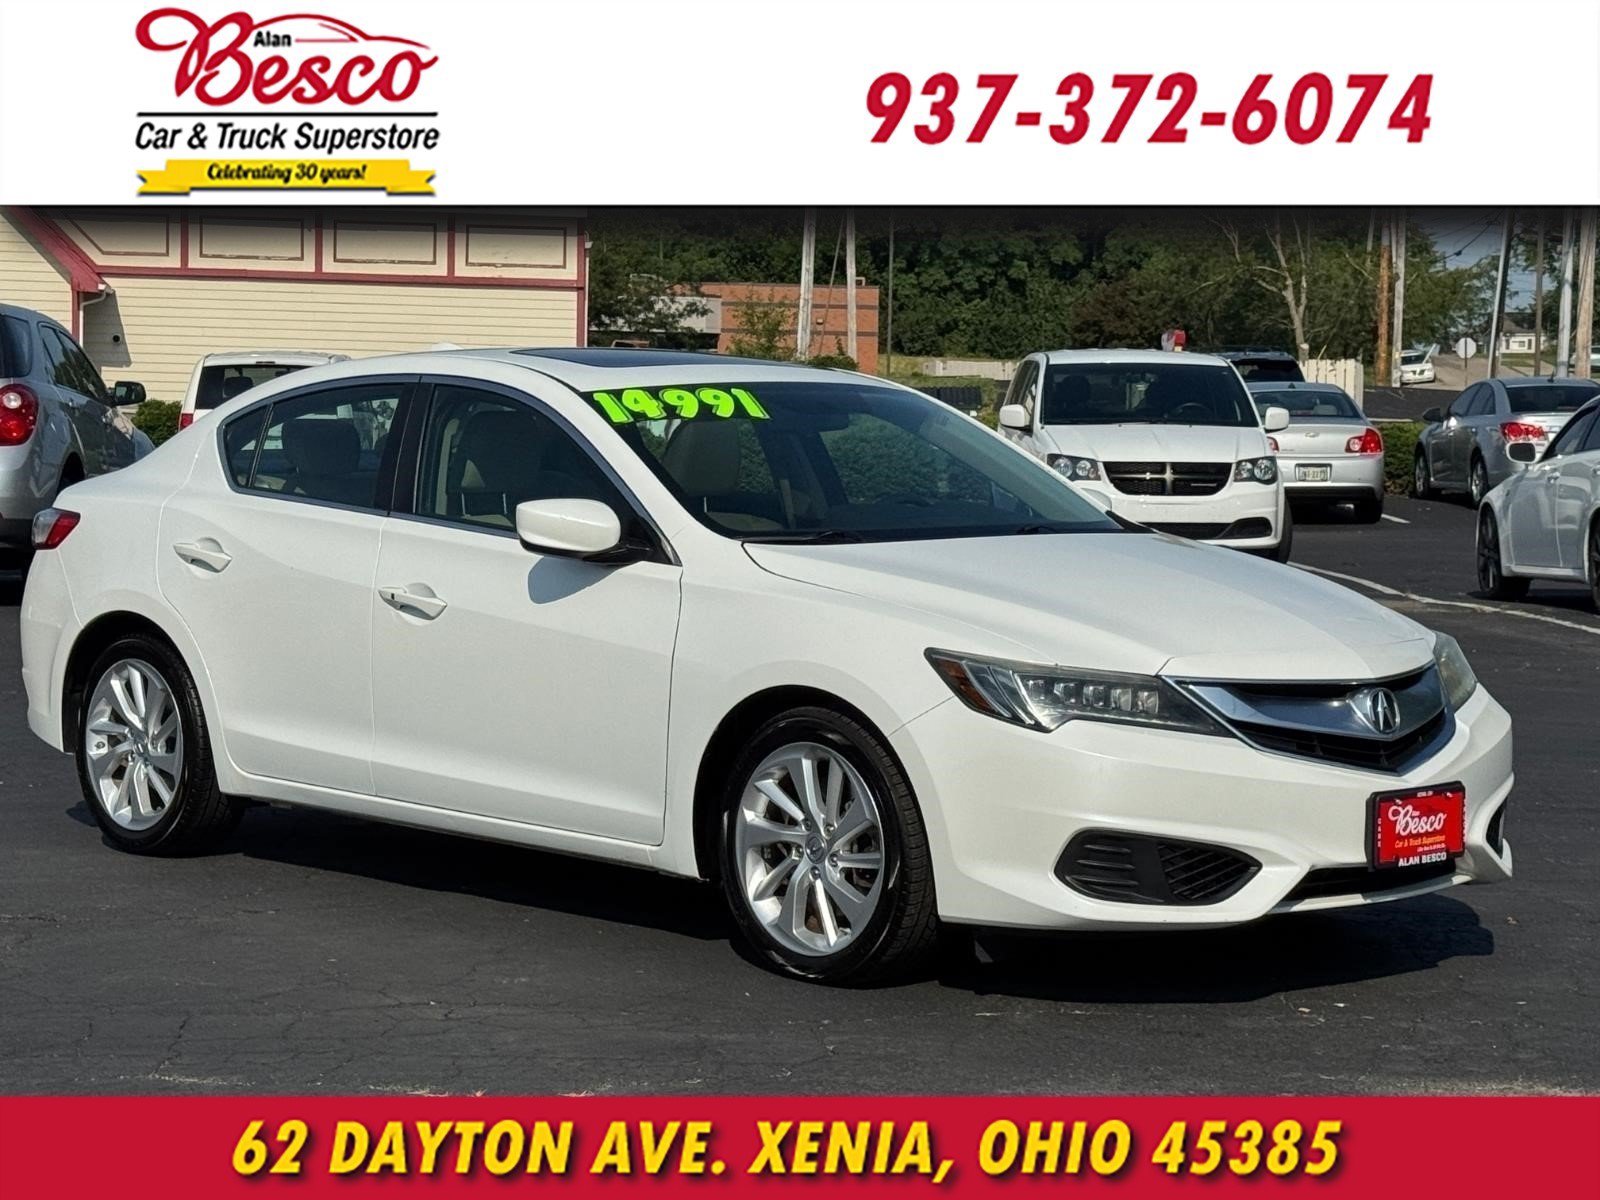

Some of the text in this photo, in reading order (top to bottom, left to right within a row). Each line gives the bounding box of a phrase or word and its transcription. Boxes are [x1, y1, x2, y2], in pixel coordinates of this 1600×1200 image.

[593, 387, 770, 424] 14991
[1388, 805, 1447, 836] Besco
[1398, 852, 1447, 867] ALAN BESCO
